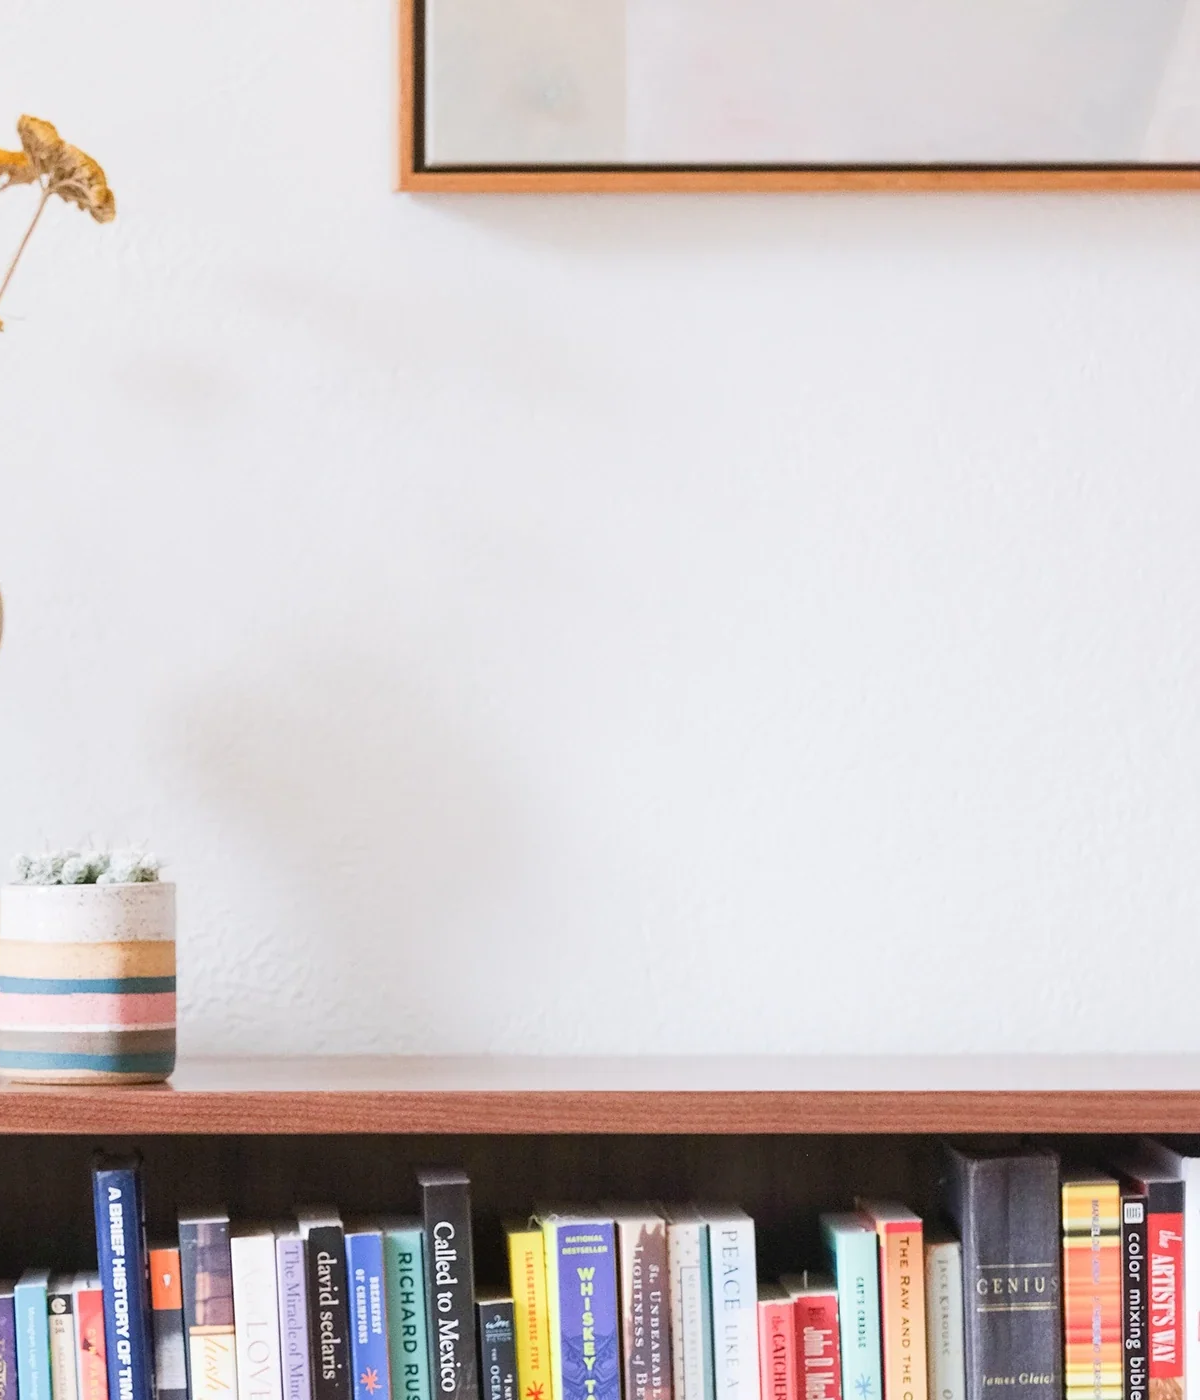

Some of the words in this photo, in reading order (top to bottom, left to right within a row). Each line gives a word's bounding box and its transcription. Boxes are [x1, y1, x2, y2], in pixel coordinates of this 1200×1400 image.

[108, 1186, 122, 1201] A
[109, 1203, 125, 1256] BRIEF
[564, 1234, 604, 1244] NATIONAL
[1157, 1229, 1184, 1250] the
[284, 1245, 300, 1279] The
[432, 1220, 459, 1285] Called
[561, 1245, 608, 1256] BESTSELLER
[899, 1237, 911, 1269] THE
[1129, 1232, 1144, 1282] color
[317, 1251, 341, 1305] david
[721, 1230, 742, 1310] PEACE
[975, 1276, 1059, 1296] GENIUS
[111, 1257, 129, 1338] HISTORY
[399, 1251, 419, 1354] RICHARD
[436, 1290, 453, 1313] to
[900, 1274, 912, 1310] RAW
[1150, 1253, 1176, 1326] ARTIST'S
[286, 1284, 303, 1338] Miracle
[576, 1266, 599, 1371] WHISKEY
[1125, 1289, 1145, 1349] mixing
[319, 1311, 343, 1380] sedaris
[725, 1324, 739, 1367] LIKE
[901, 1316, 912, 1349] AND
[1151, 1328, 1176, 1364] WAY
[116, 1339, 132, 1366] OF
[289, 1342, 303, 1361] of
[437, 1317, 462, 1393] Mexico
[503, 1374, 514, 1384] #1
[727, 1378, 739, 1389] A
[902, 1355, 912, 1385] THE
